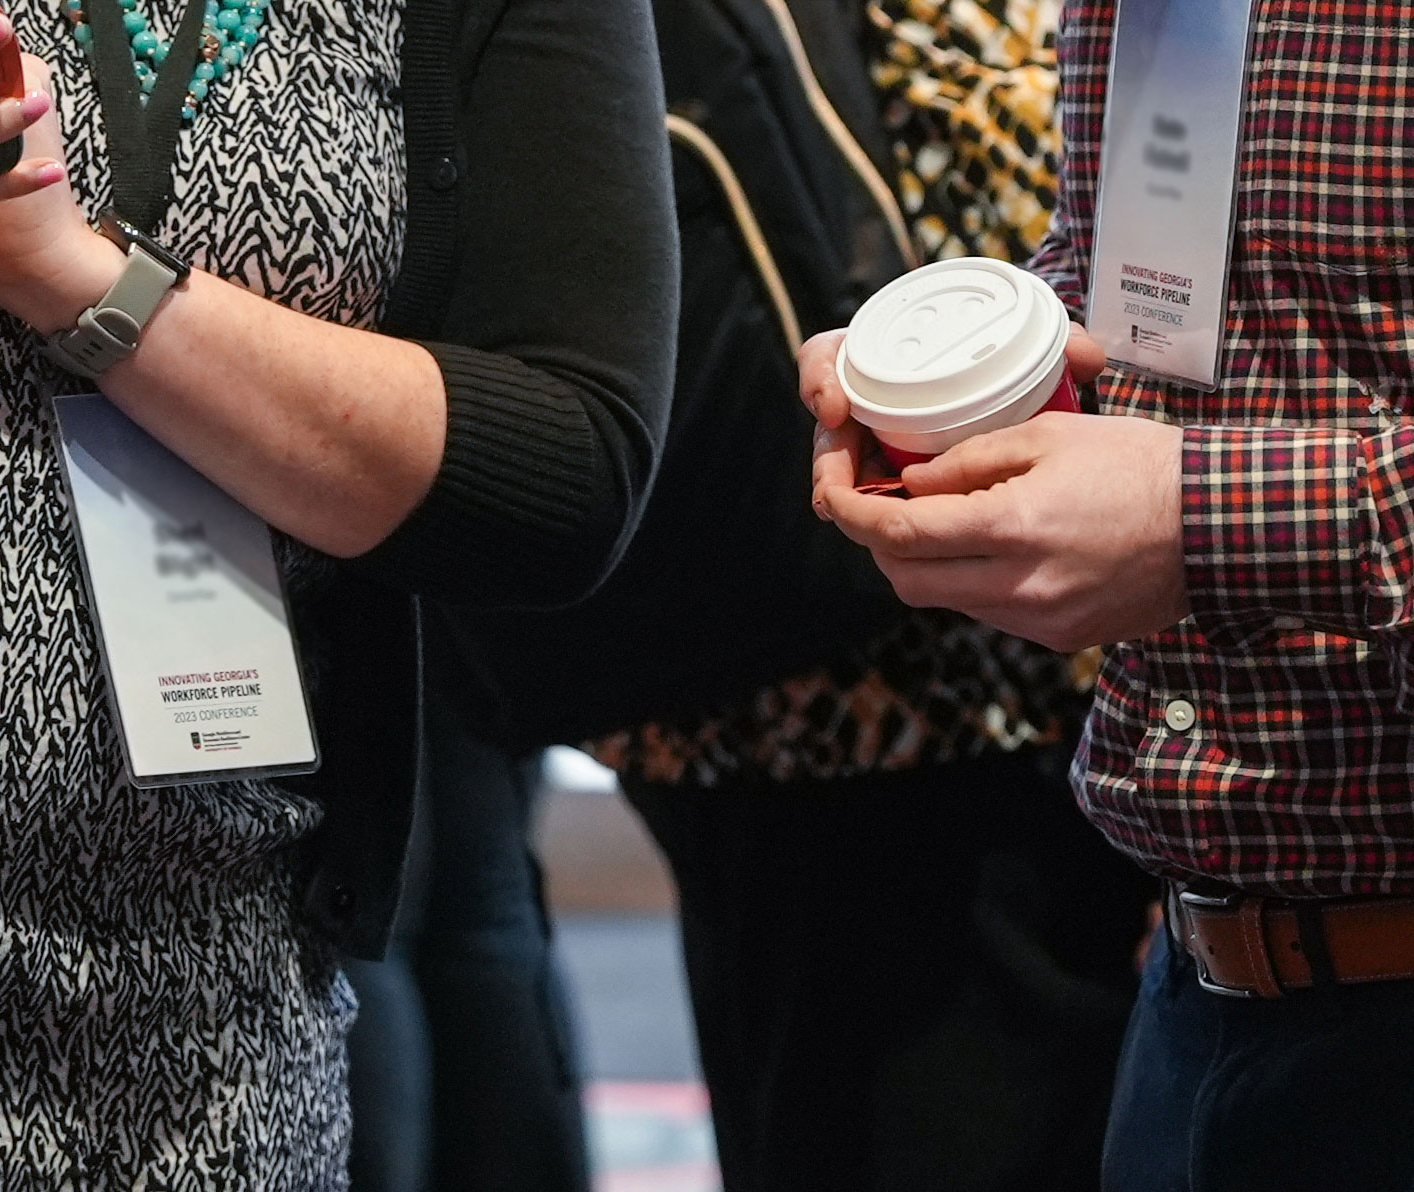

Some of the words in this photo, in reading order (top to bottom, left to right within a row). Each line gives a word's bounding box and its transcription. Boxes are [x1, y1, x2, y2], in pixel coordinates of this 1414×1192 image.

[1122, 263, 1158, 281] INNOVATING
[1159, 272, 1193, 289] GEORGIA'S
[1120, 278, 1160, 299] WORKFORCE
[1161, 288, 1191, 306] PIPELINE
[1141, 306, 1184, 326] CONFERENCE
[158, 672, 212, 687] INNOVATING
[213, 669, 259, 682] GEORGIA'S
[160, 687, 219, 703] WORKFORCE
[220, 683, 262, 698] PIPELINE
[173, 711, 198, 723] 2023
[199, 706, 259, 721] CONFERENCE
